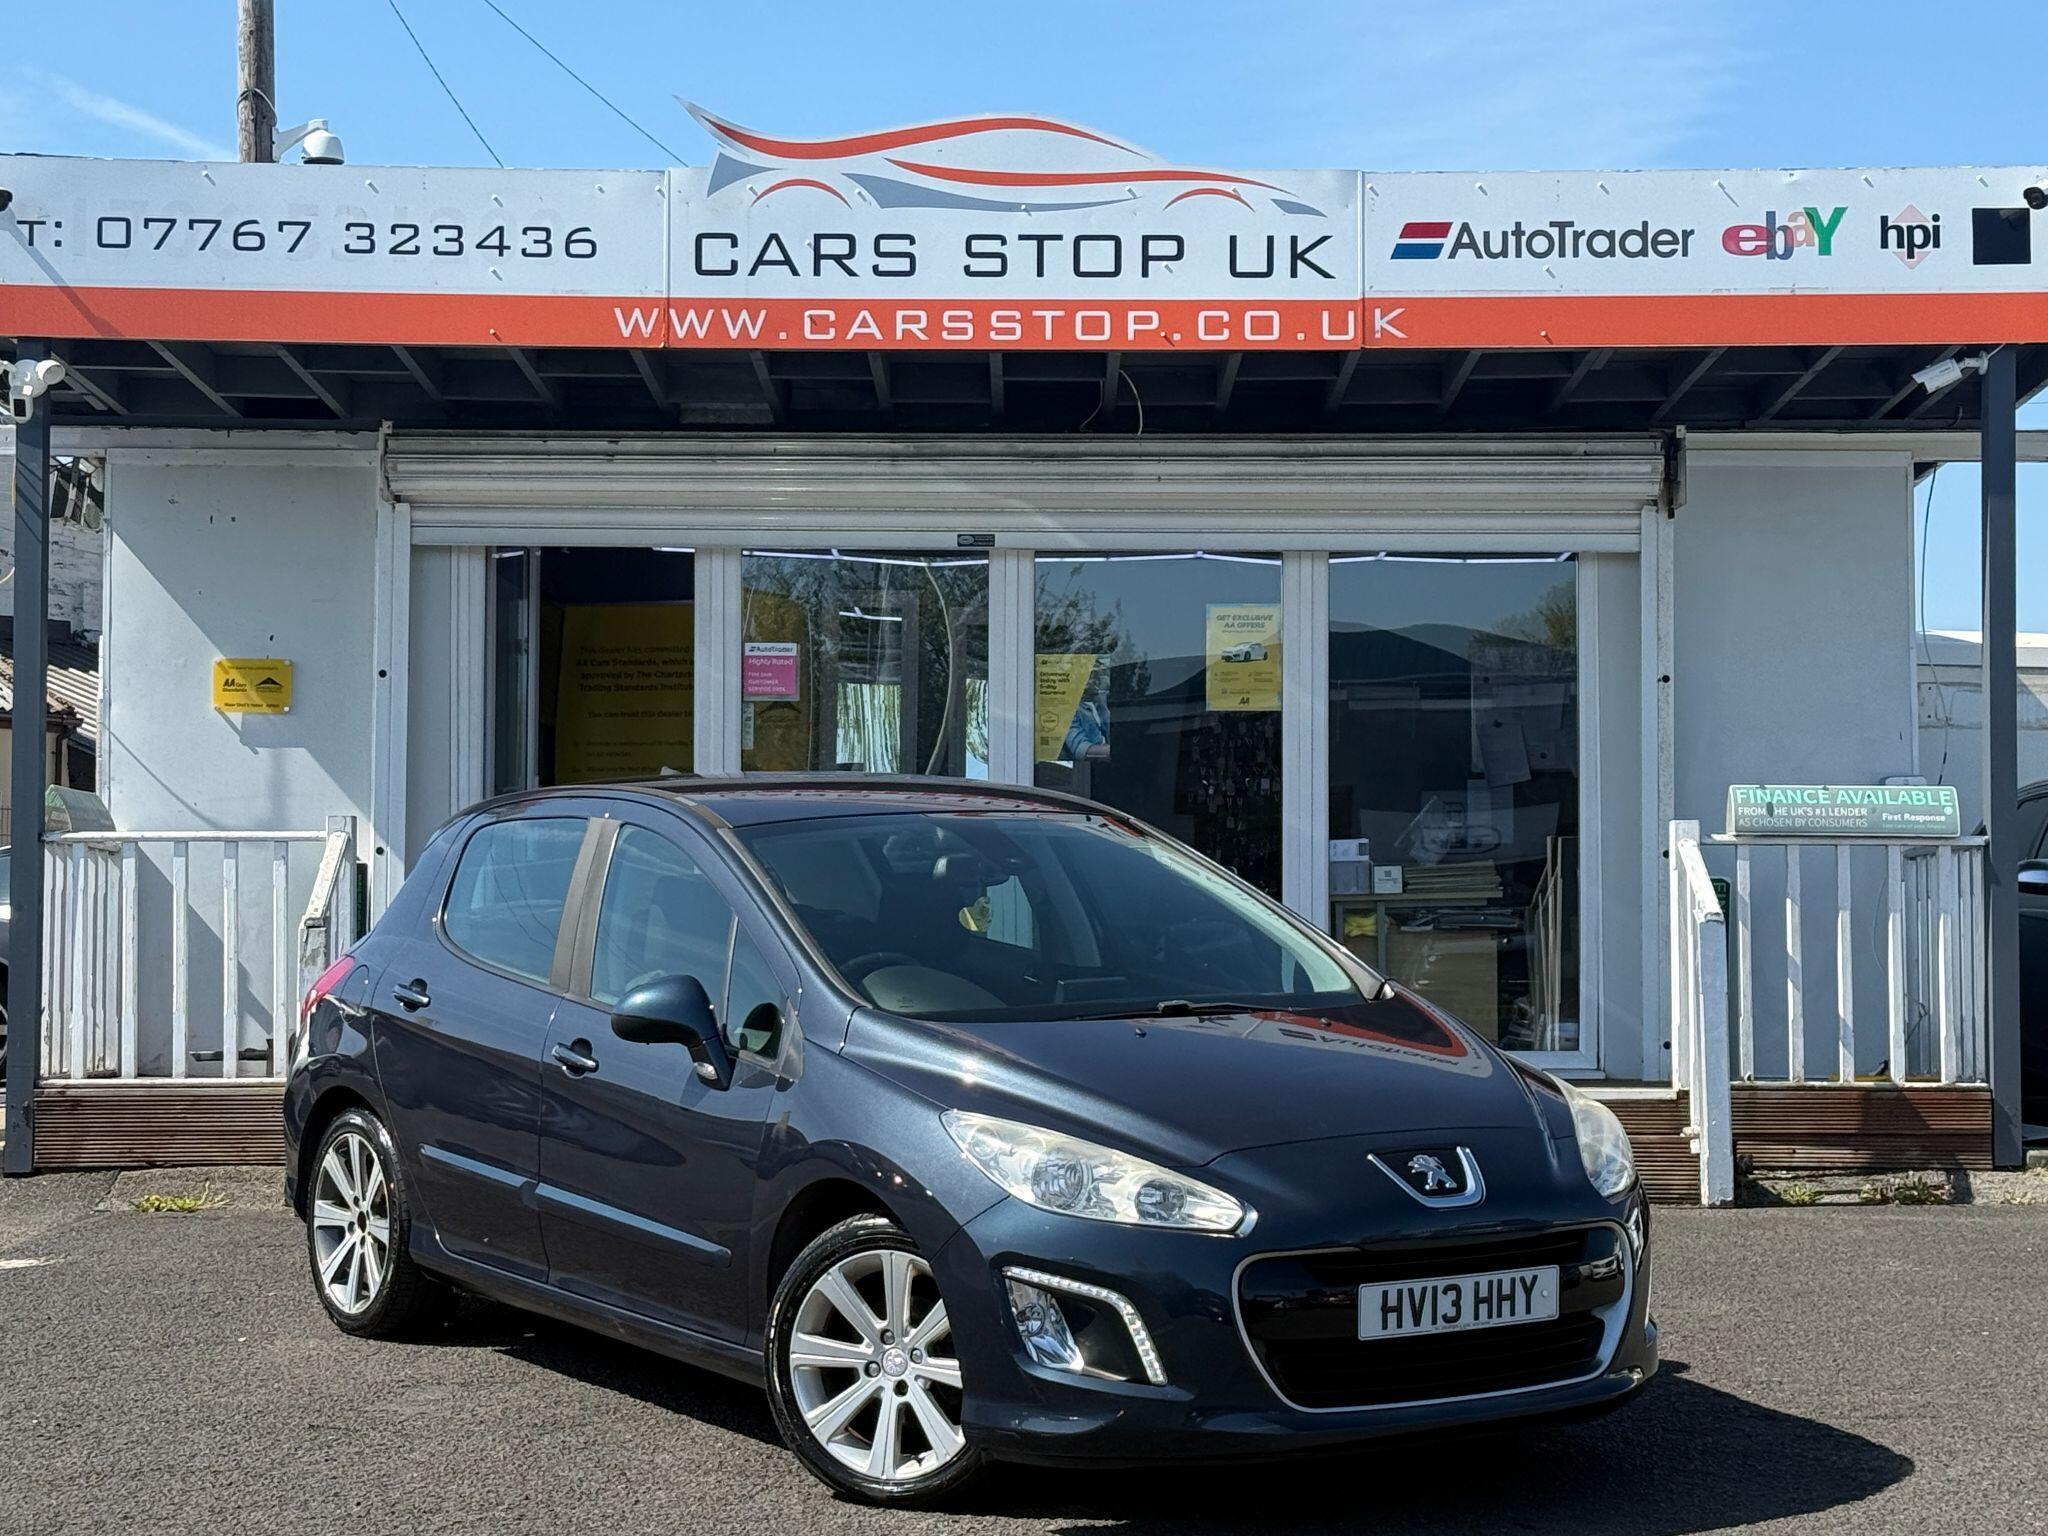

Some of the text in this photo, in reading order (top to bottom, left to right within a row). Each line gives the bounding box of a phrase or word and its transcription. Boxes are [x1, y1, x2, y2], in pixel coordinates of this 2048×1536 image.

[16, 216, 597, 259] T: 07767 323436
[1447, 220, 1695, 260] AutoTrader
[1880, 213, 1941, 259] hpi
[694, 232, 1336, 279] CARS STOP UK
[613, 307, 1408, 342] WWW.CARSSTOP.CO.UK
[1735, 789, 1954, 806] FINANCE AVAILABLE
[1738, 806, 1766, 817] FROM
[1767, 806, 1788, 817] HE
[1828, 807, 1869, 818] LENDER
[1738, 818, 1869, 829] AS CHOSEN BY CONSUMERS
[1882, 813, 1947, 823] First Response
[1380, 1274, 1539, 1331] HV13 HHY
